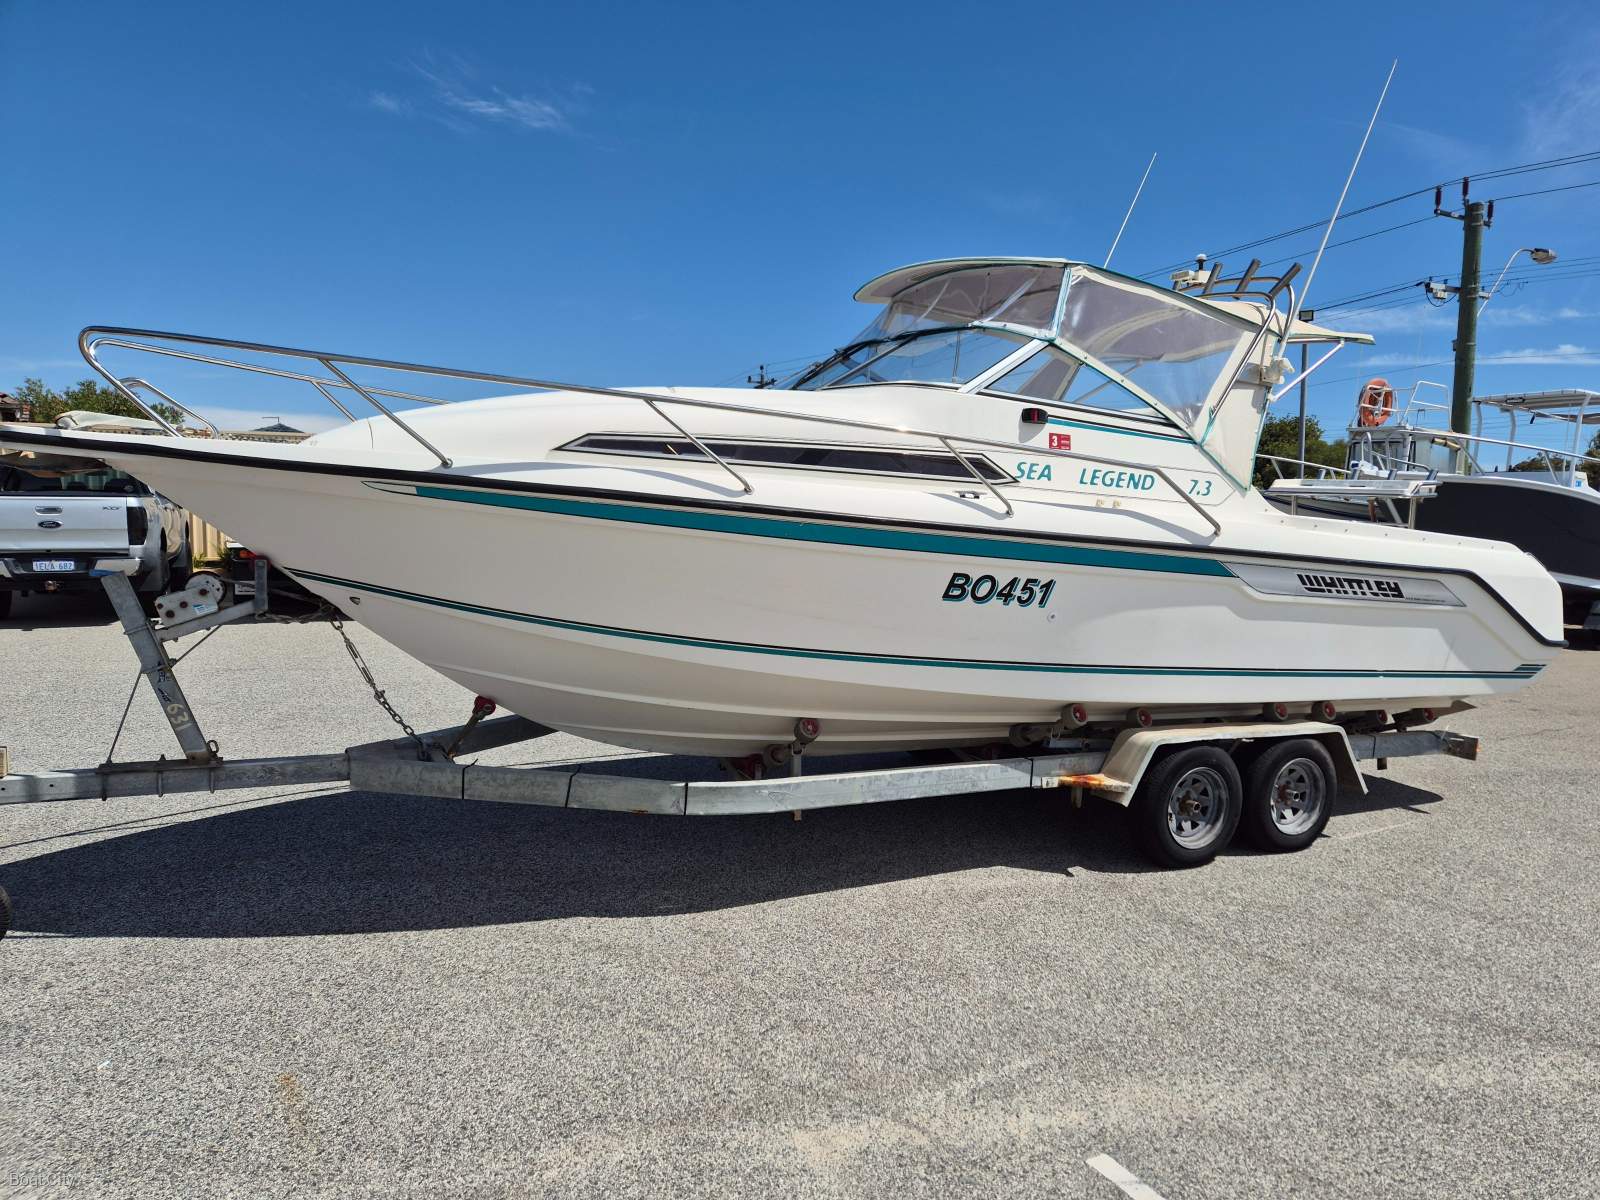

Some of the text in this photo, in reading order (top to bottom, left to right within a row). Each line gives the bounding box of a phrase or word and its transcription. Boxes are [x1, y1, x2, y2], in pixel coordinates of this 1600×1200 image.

[1015, 461, 1212, 496] SEA LEGEND 7.3
[941, 572, 1057, 608] BO451
[1296, 573, 1405, 598] WHITTLEY
